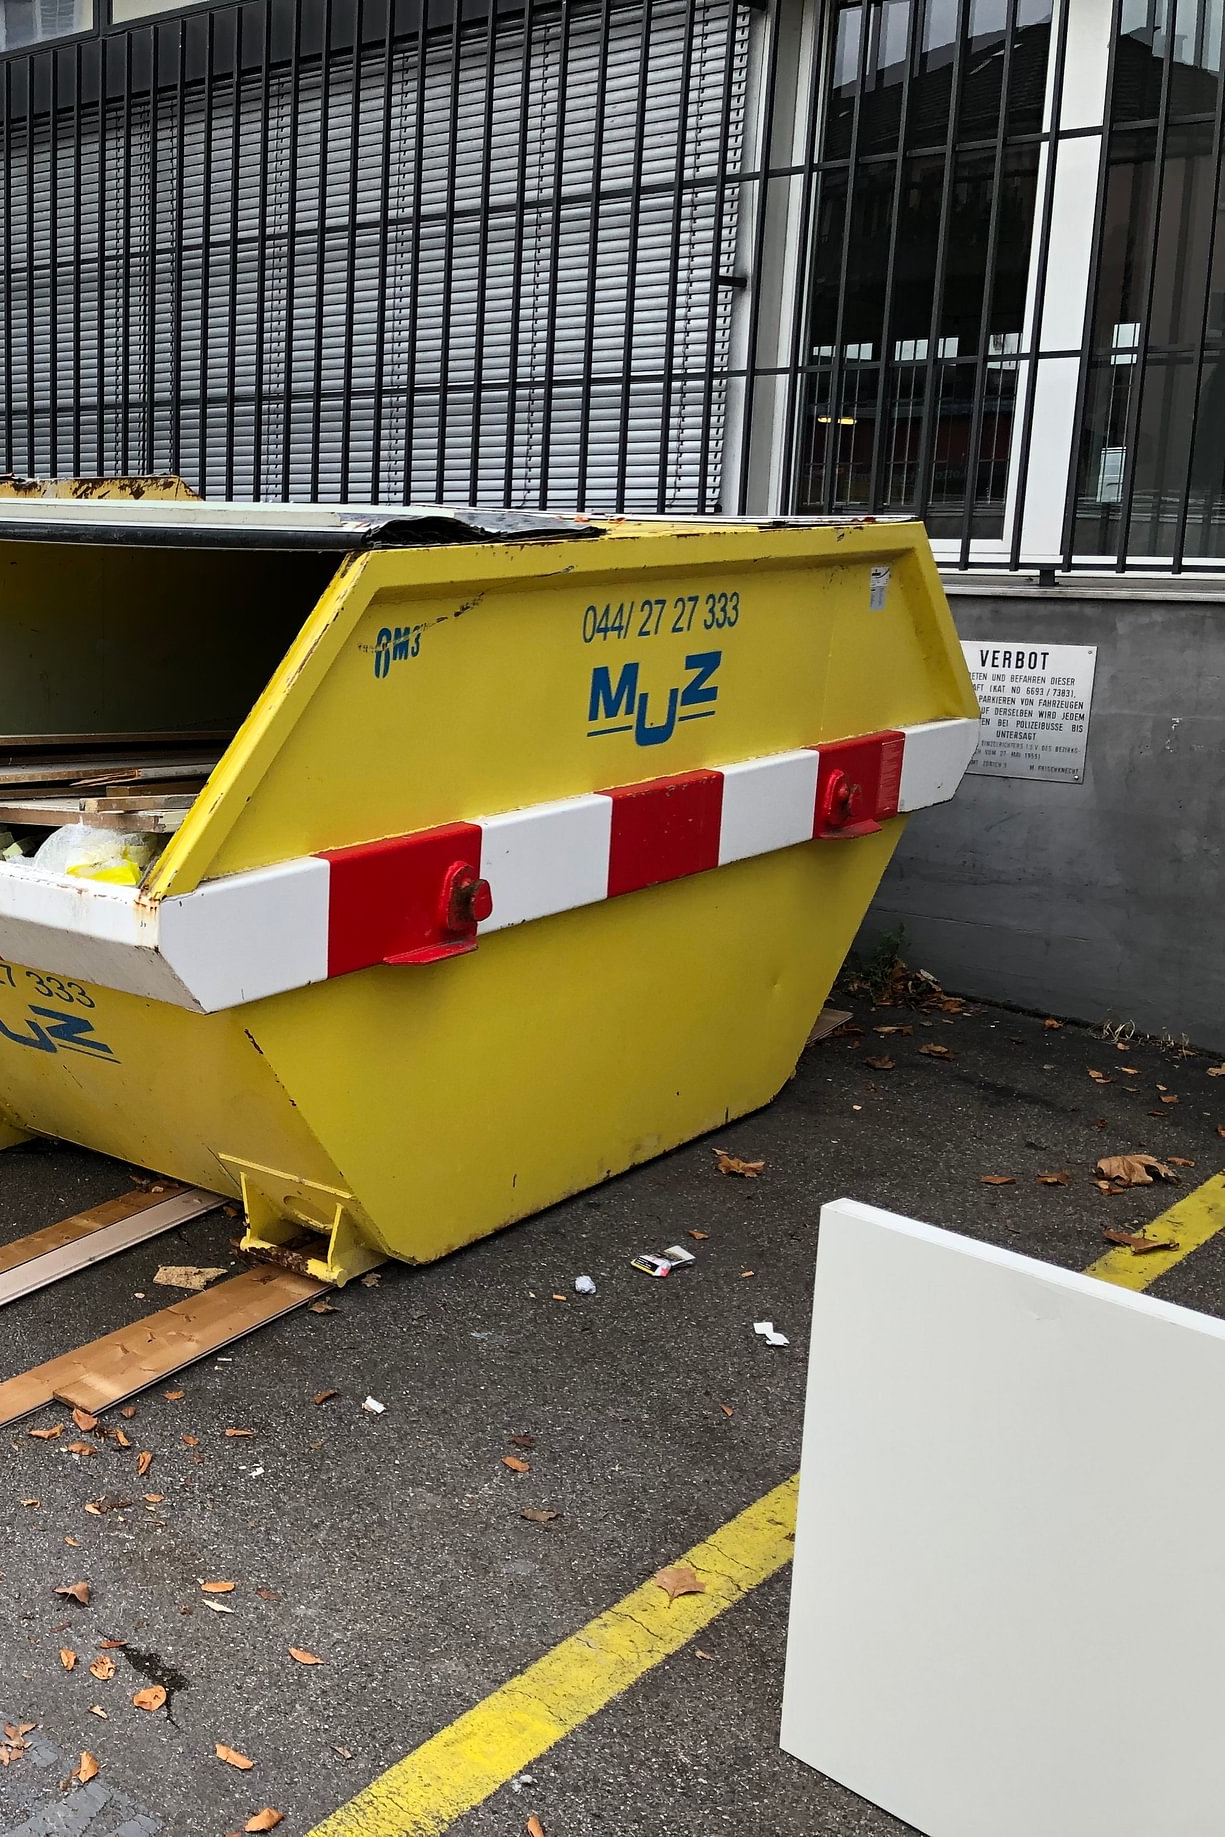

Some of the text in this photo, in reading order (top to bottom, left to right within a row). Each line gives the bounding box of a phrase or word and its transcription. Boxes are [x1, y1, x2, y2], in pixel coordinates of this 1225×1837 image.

[637, 599, 667, 637] 27
[671, 595, 700, 634] 27
[703, 591, 740, 630] 333
[979, 649, 1050, 671] VERBOT
[991, 673, 1006, 682] UND
[1010, 674, 1046, 685] BEFAHREN
[1050, 677, 1076, 686] DIESER
[587, 650, 723, 747] MUZ
[1026, 687, 1044, 696] 6693
[978, 694, 1084, 710] PARKIEREN VON FAHRZEUGEN
[994, 707, 1033, 718] DERSELBEN
[1038, 710, 1057, 720] WIRD
[1061, 712, 1085, 721] JEDEM
[997, 718, 1009, 727] BEI
[1015, 719, 1064, 732] POLIZEIBUSSE
[1071, 724, 1084, 733] BIS
[995, 729, 1037, 741] UNTERSAGT
[24, 970, 96, 1009] 333
